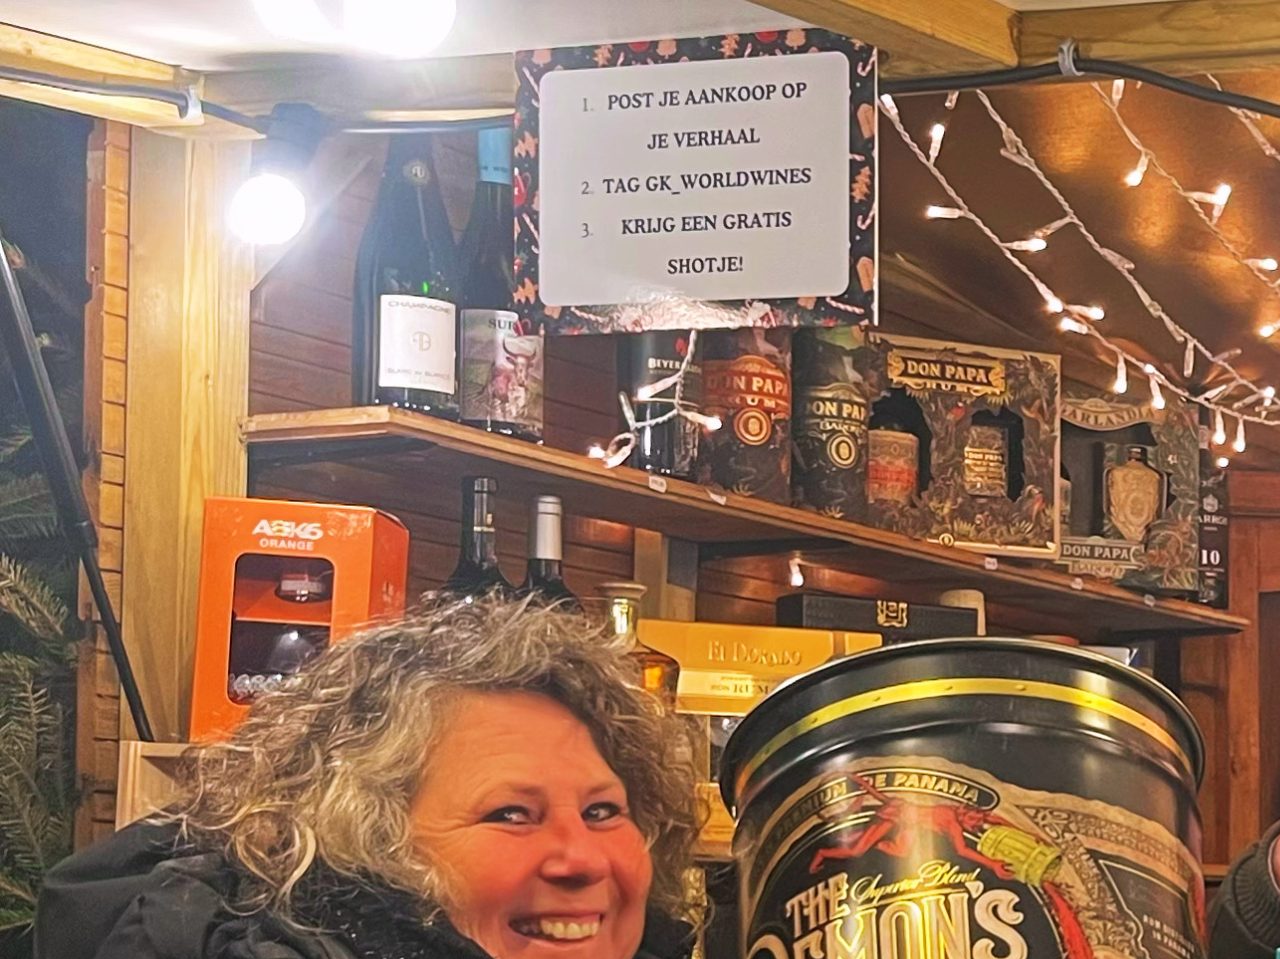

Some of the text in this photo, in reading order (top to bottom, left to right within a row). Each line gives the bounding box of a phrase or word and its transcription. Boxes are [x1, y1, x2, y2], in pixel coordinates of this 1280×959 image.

[582, 82, 808, 112] 1. POST JE AANKOOP OP
[647, 128, 760, 150] JE VERHAAL
[581, 167, 812, 196] 2. TAG GK_WORLDWINES
[581, 211, 793, 238] 3. KRIJG EEN GRATIS
[667, 256, 744, 275] SHOTJE!
[907, 359, 988, 384] DON PAPA
[259, 537, 315, 552] ORANGE
[1062, 544, 1129, 559] DON PAPA
[1201, 549, 1221, 563] 10
[893, 773, 980, 803] PANAMA
[785, 872, 850, 938] THE
